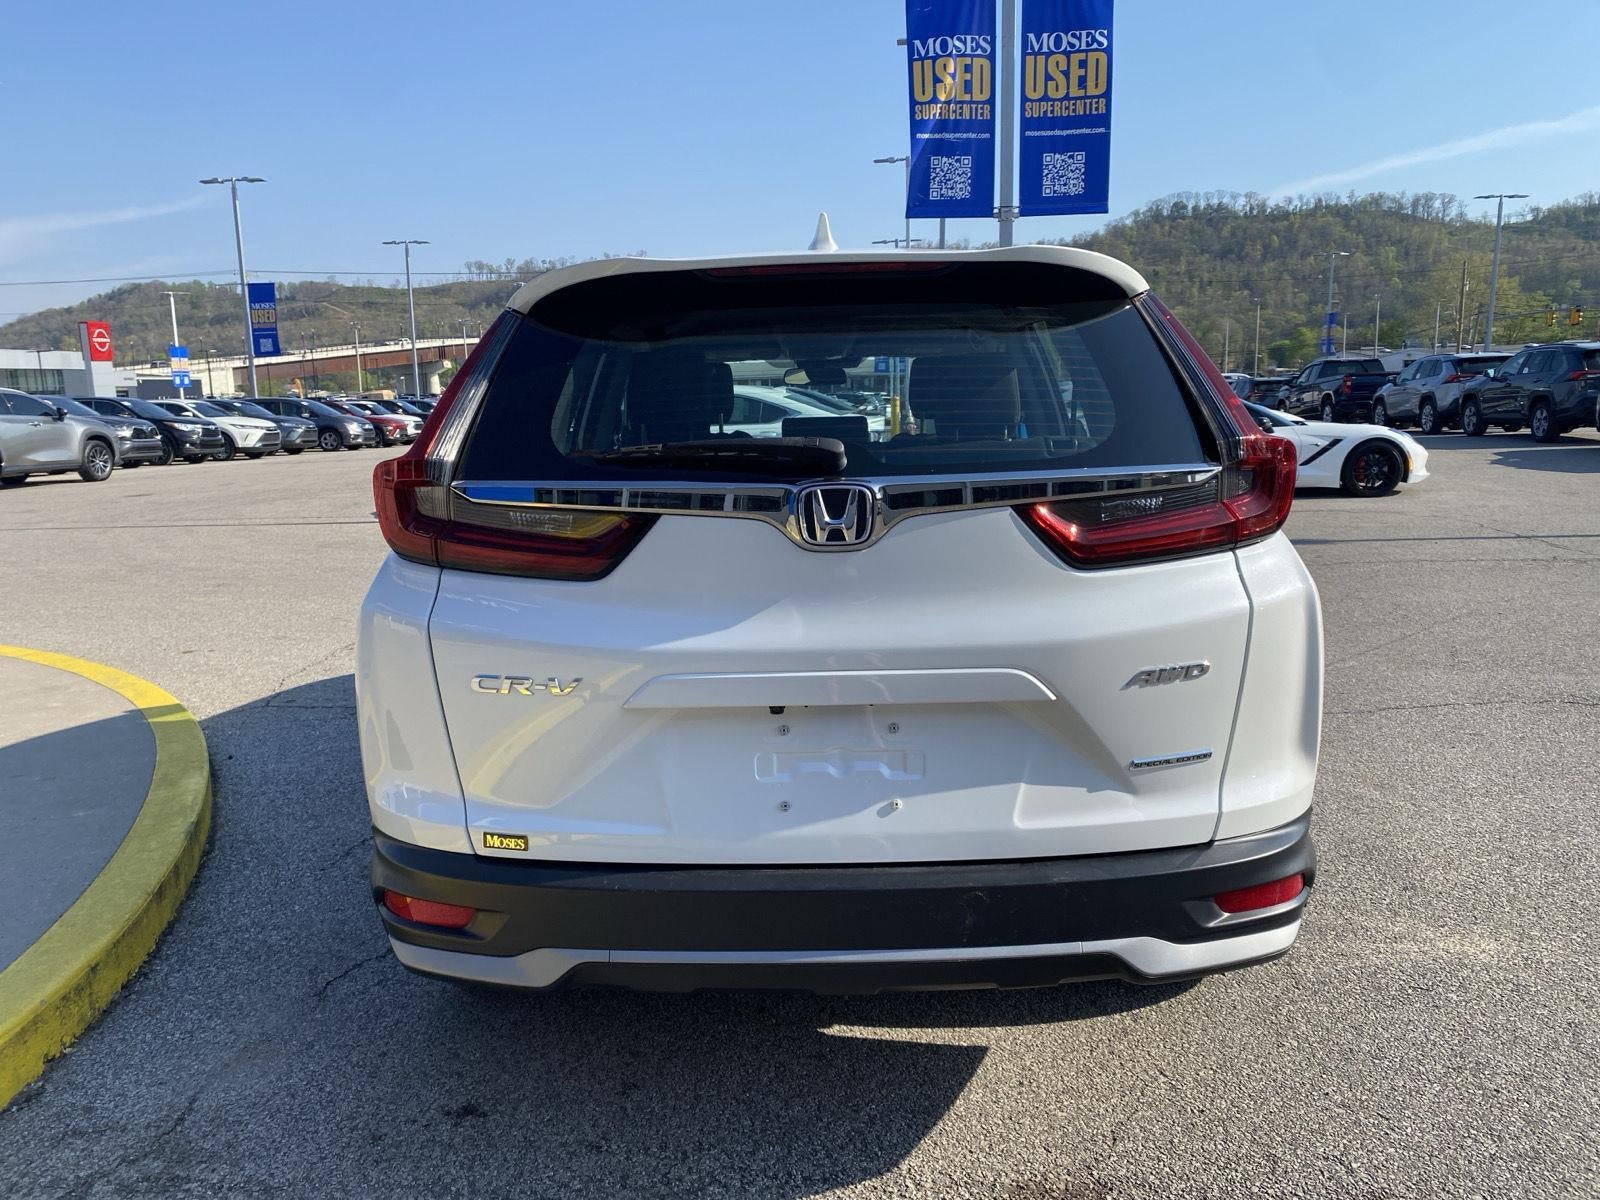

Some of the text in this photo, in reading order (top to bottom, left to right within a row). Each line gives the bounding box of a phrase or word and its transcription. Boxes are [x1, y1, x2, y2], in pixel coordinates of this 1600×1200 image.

[912, 35, 991, 59] MOSES
[1026, 29, 1108, 53] MOSES
[912, 56, 991, 102] USED
[1025, 51, 1108, 99] USED
[914, 103, 991, 120] SUPERCENTER
[1024, 98, 1106, 118] SUPERCENTER
[915, 132, 991, 140] mosesusedsupercenter.com
[1024, 127, 1106, 137] mosesusedsupercenter.com
[251, 302, 275, 310] MOSES
[251, 309, 276, 323] USED
[1119, 660, 1210, 691] AWD
[470, 674, 583, 697] CR-V
[1132, 752, 1213, 769] SPECIAL EDITION
[486, 834, 526, 850] MOSES
